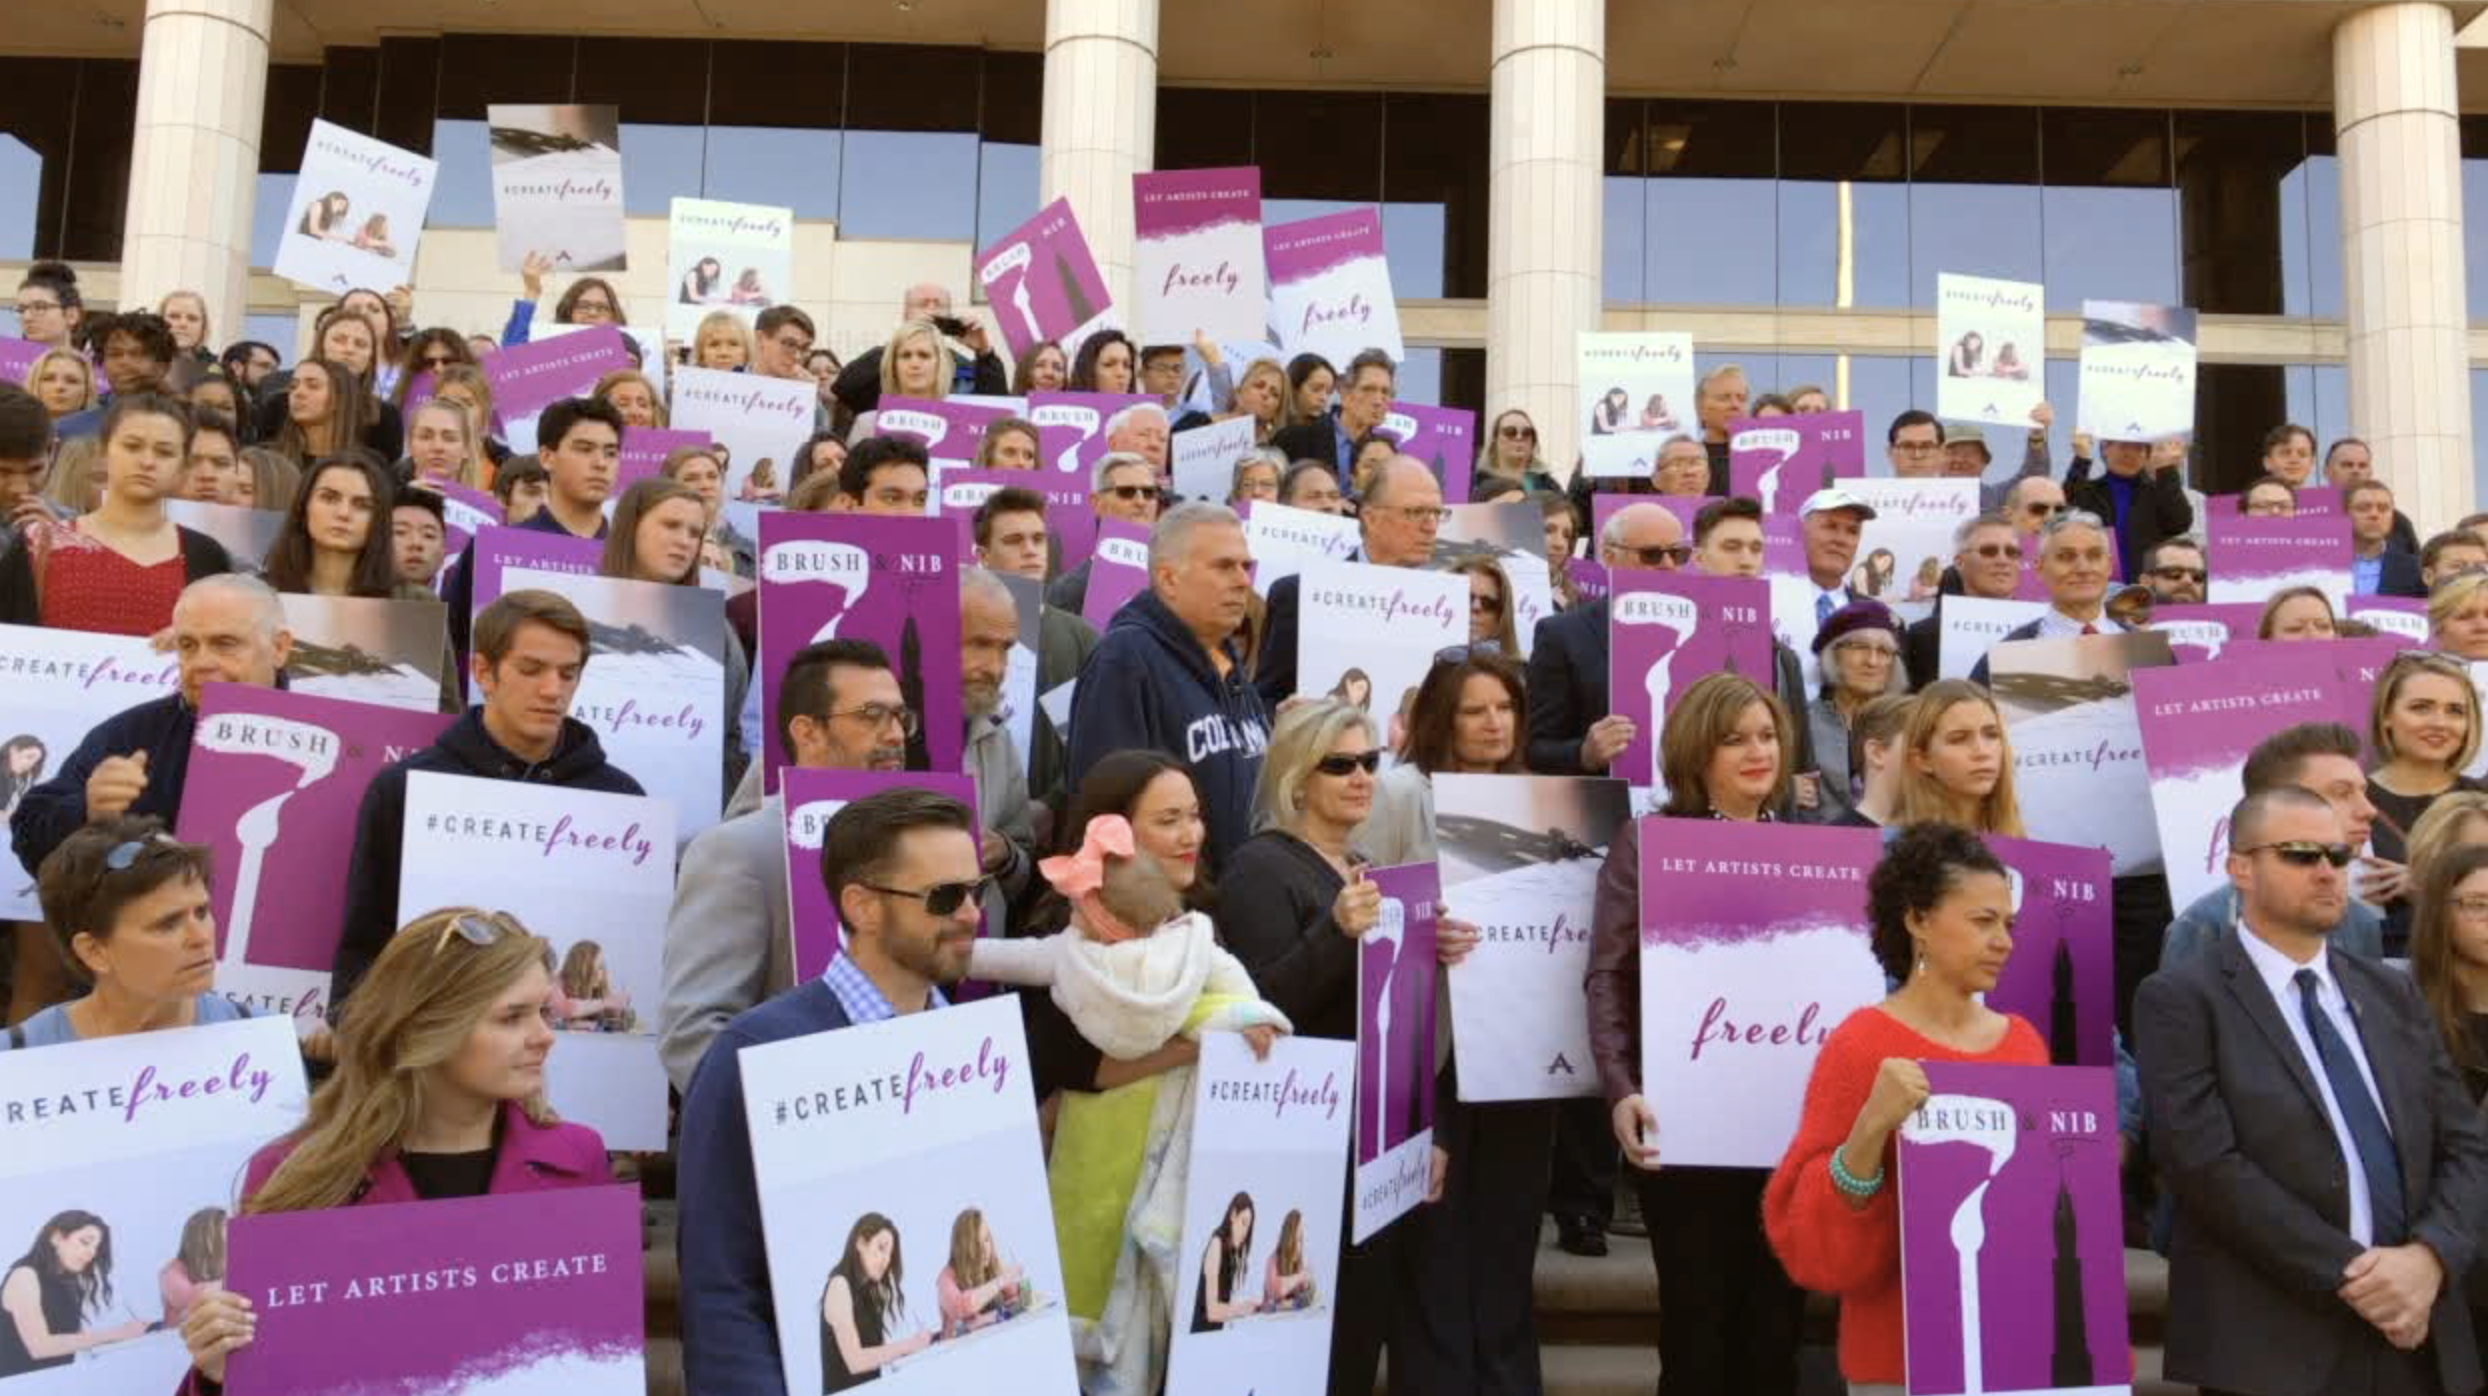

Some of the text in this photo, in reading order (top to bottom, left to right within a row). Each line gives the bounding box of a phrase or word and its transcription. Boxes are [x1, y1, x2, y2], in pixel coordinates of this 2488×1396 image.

[1163, 261, 1239, 297] freely
[1302, 293, 1371, 335] freely
[1047, 492, 1083, 505] NIB
[777, 552, 860, 571] BRUSH
[900, 553, 943, 573] NIB
[1109, 543, 1147, 563] BRU
[1623, 600, 1690, 619] BRUSH
[1722, 605, 1757, 623] NIB
[2155, 687, 2323, 716] LET ARTISTS CREATE
[215, 721, 328, 756] BRUSH
[1662, 857, 1862, 881] LET ARTISTS CREATE
[2053, 879, 2096, 901] NIB
[1690, 997, 1829, 1062] freel
[6, 1051, 273, 1124] REATEfreely
[1916, 1108, 2008, 1131] BRUSH
[2049, 1111, 2098, 1133] NIB
[268, 1253, 608, 1307] LET ARTISTS CREATE
